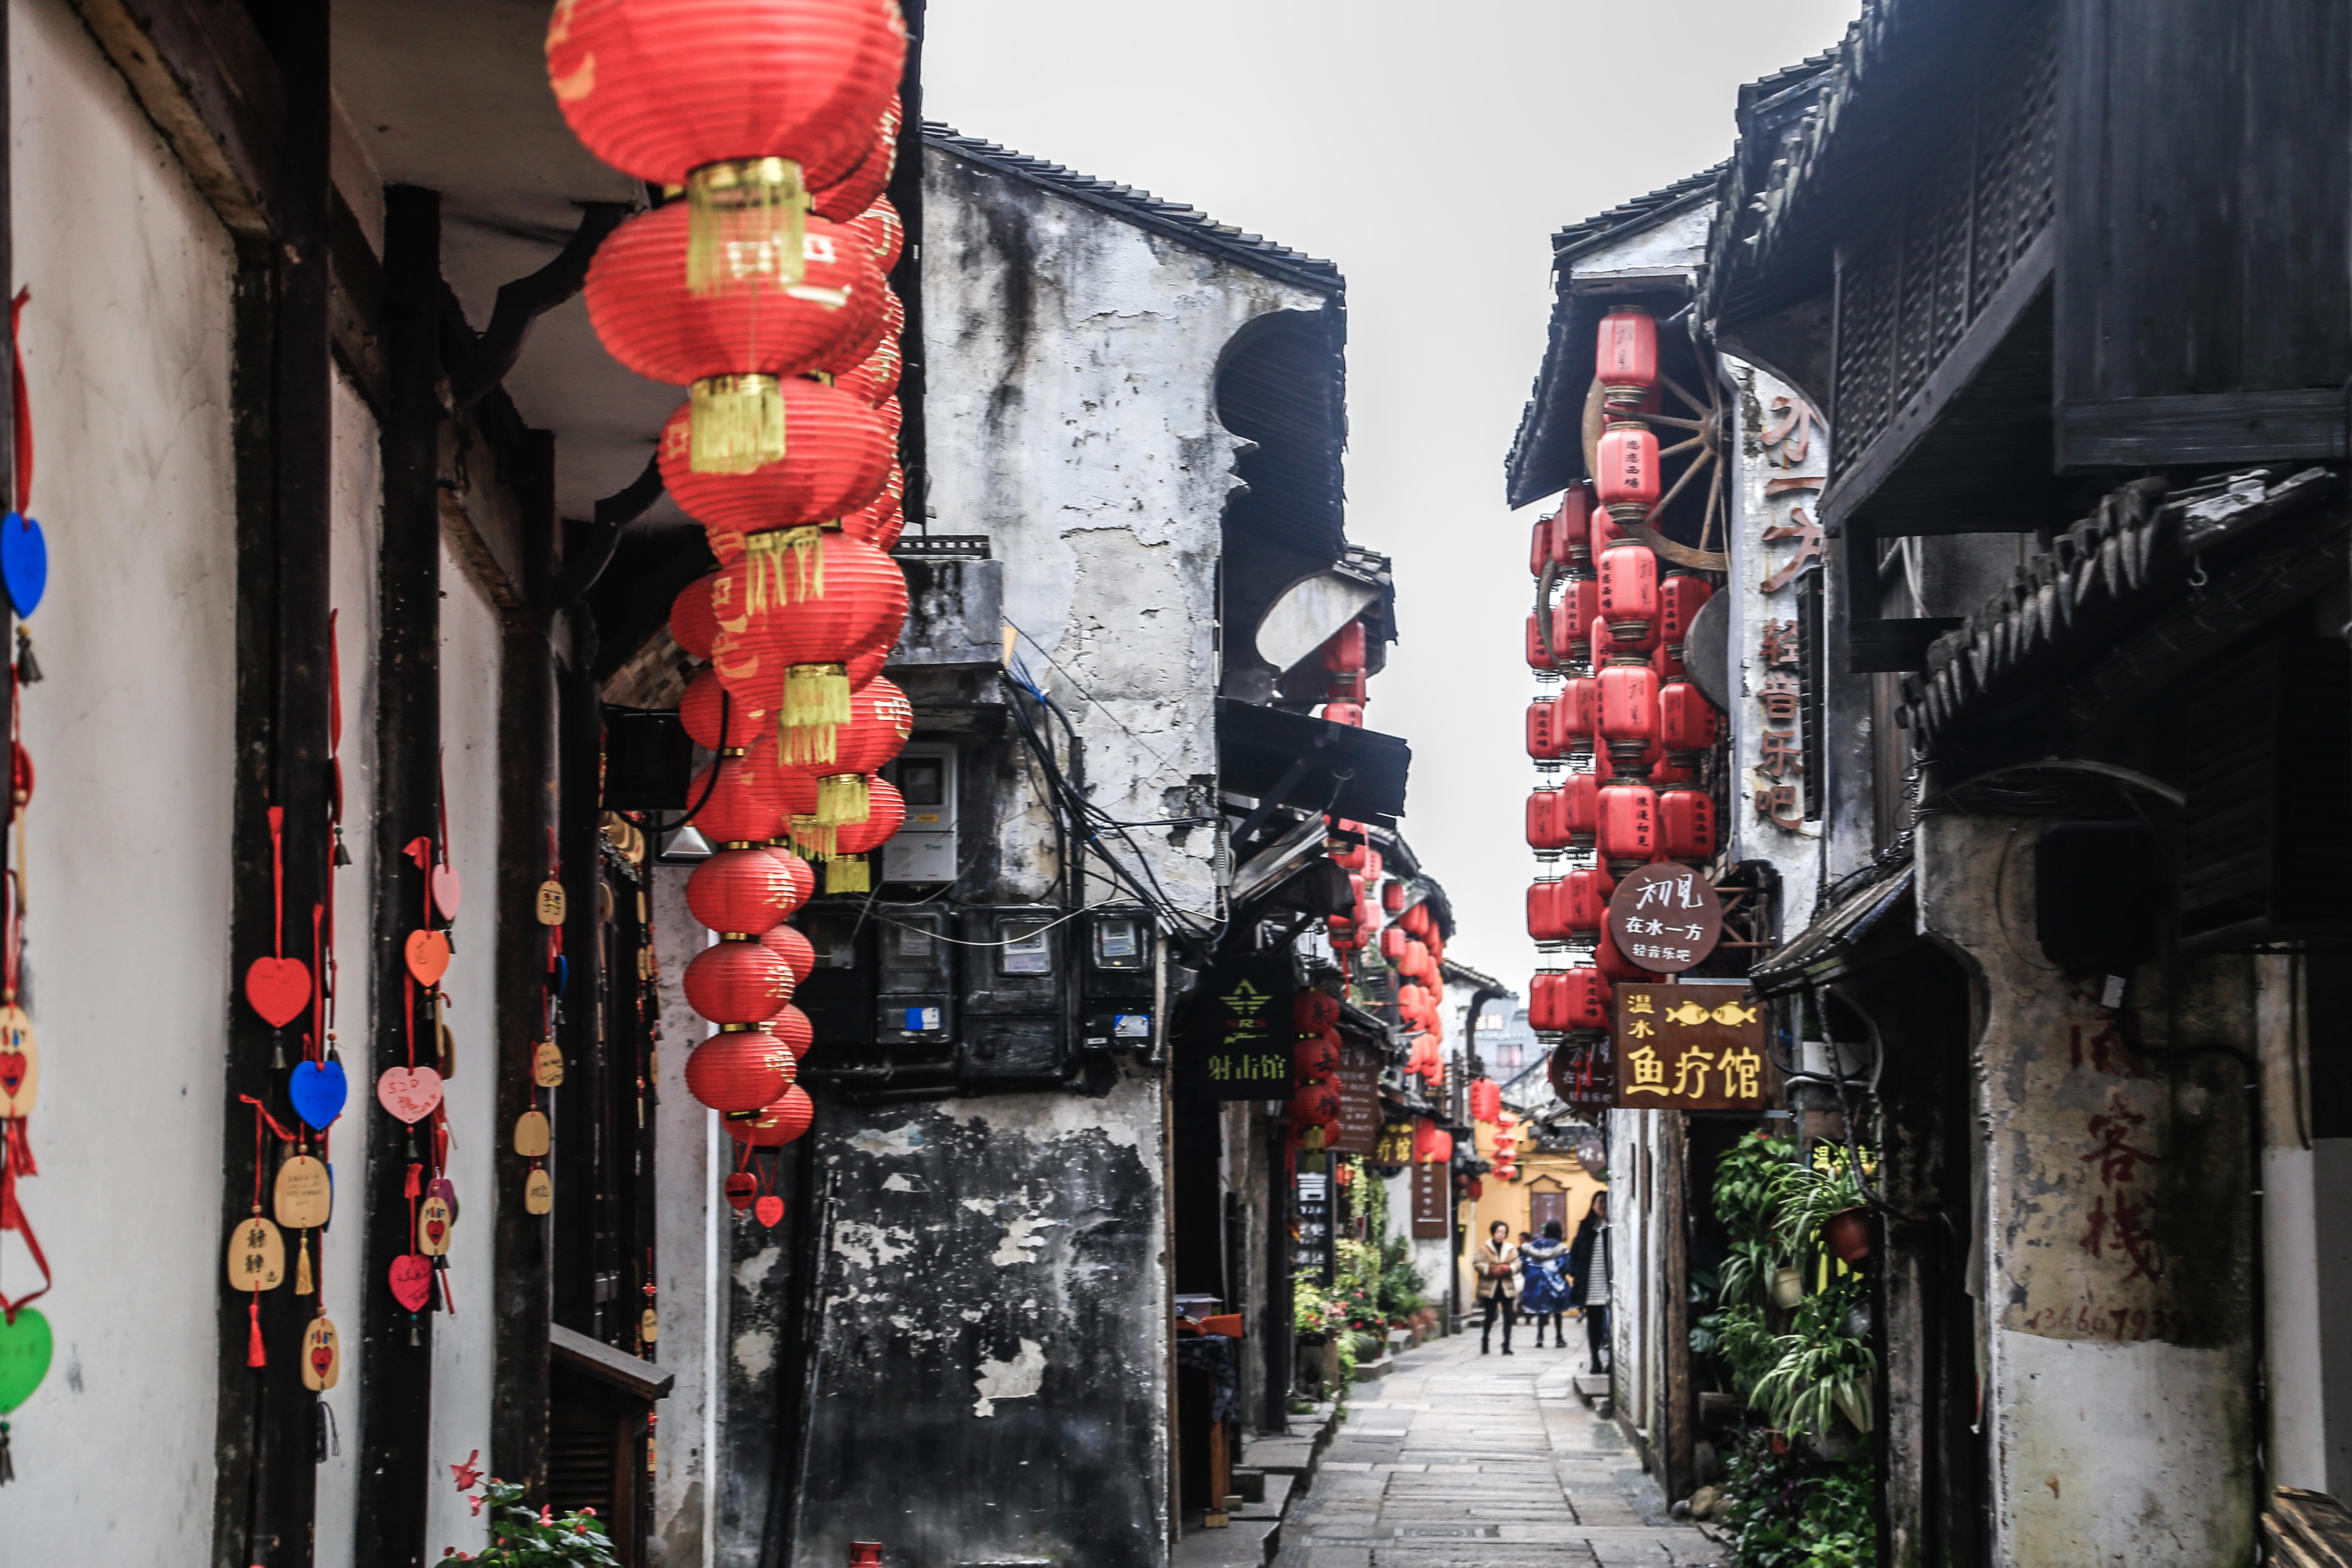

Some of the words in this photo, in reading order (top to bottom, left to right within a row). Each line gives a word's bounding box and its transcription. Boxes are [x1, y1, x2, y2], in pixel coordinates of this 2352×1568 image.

[1753, 618, 1804, 830] 轻音乐吧
[1625, 916, 1704, 941] 在水一方
[1632, 943, 1692, 962] 轻音乐吧
[1226, 1019, 1267, 1028] SRS
[1627, 994, 1656, 1038] 温水
[1209, 1055, 1287, 1080] 射击馆
[1625, 1045, 1761, 1099] 鱼疗馆
[1362, 1137, 1412, 1162] 疗馆
